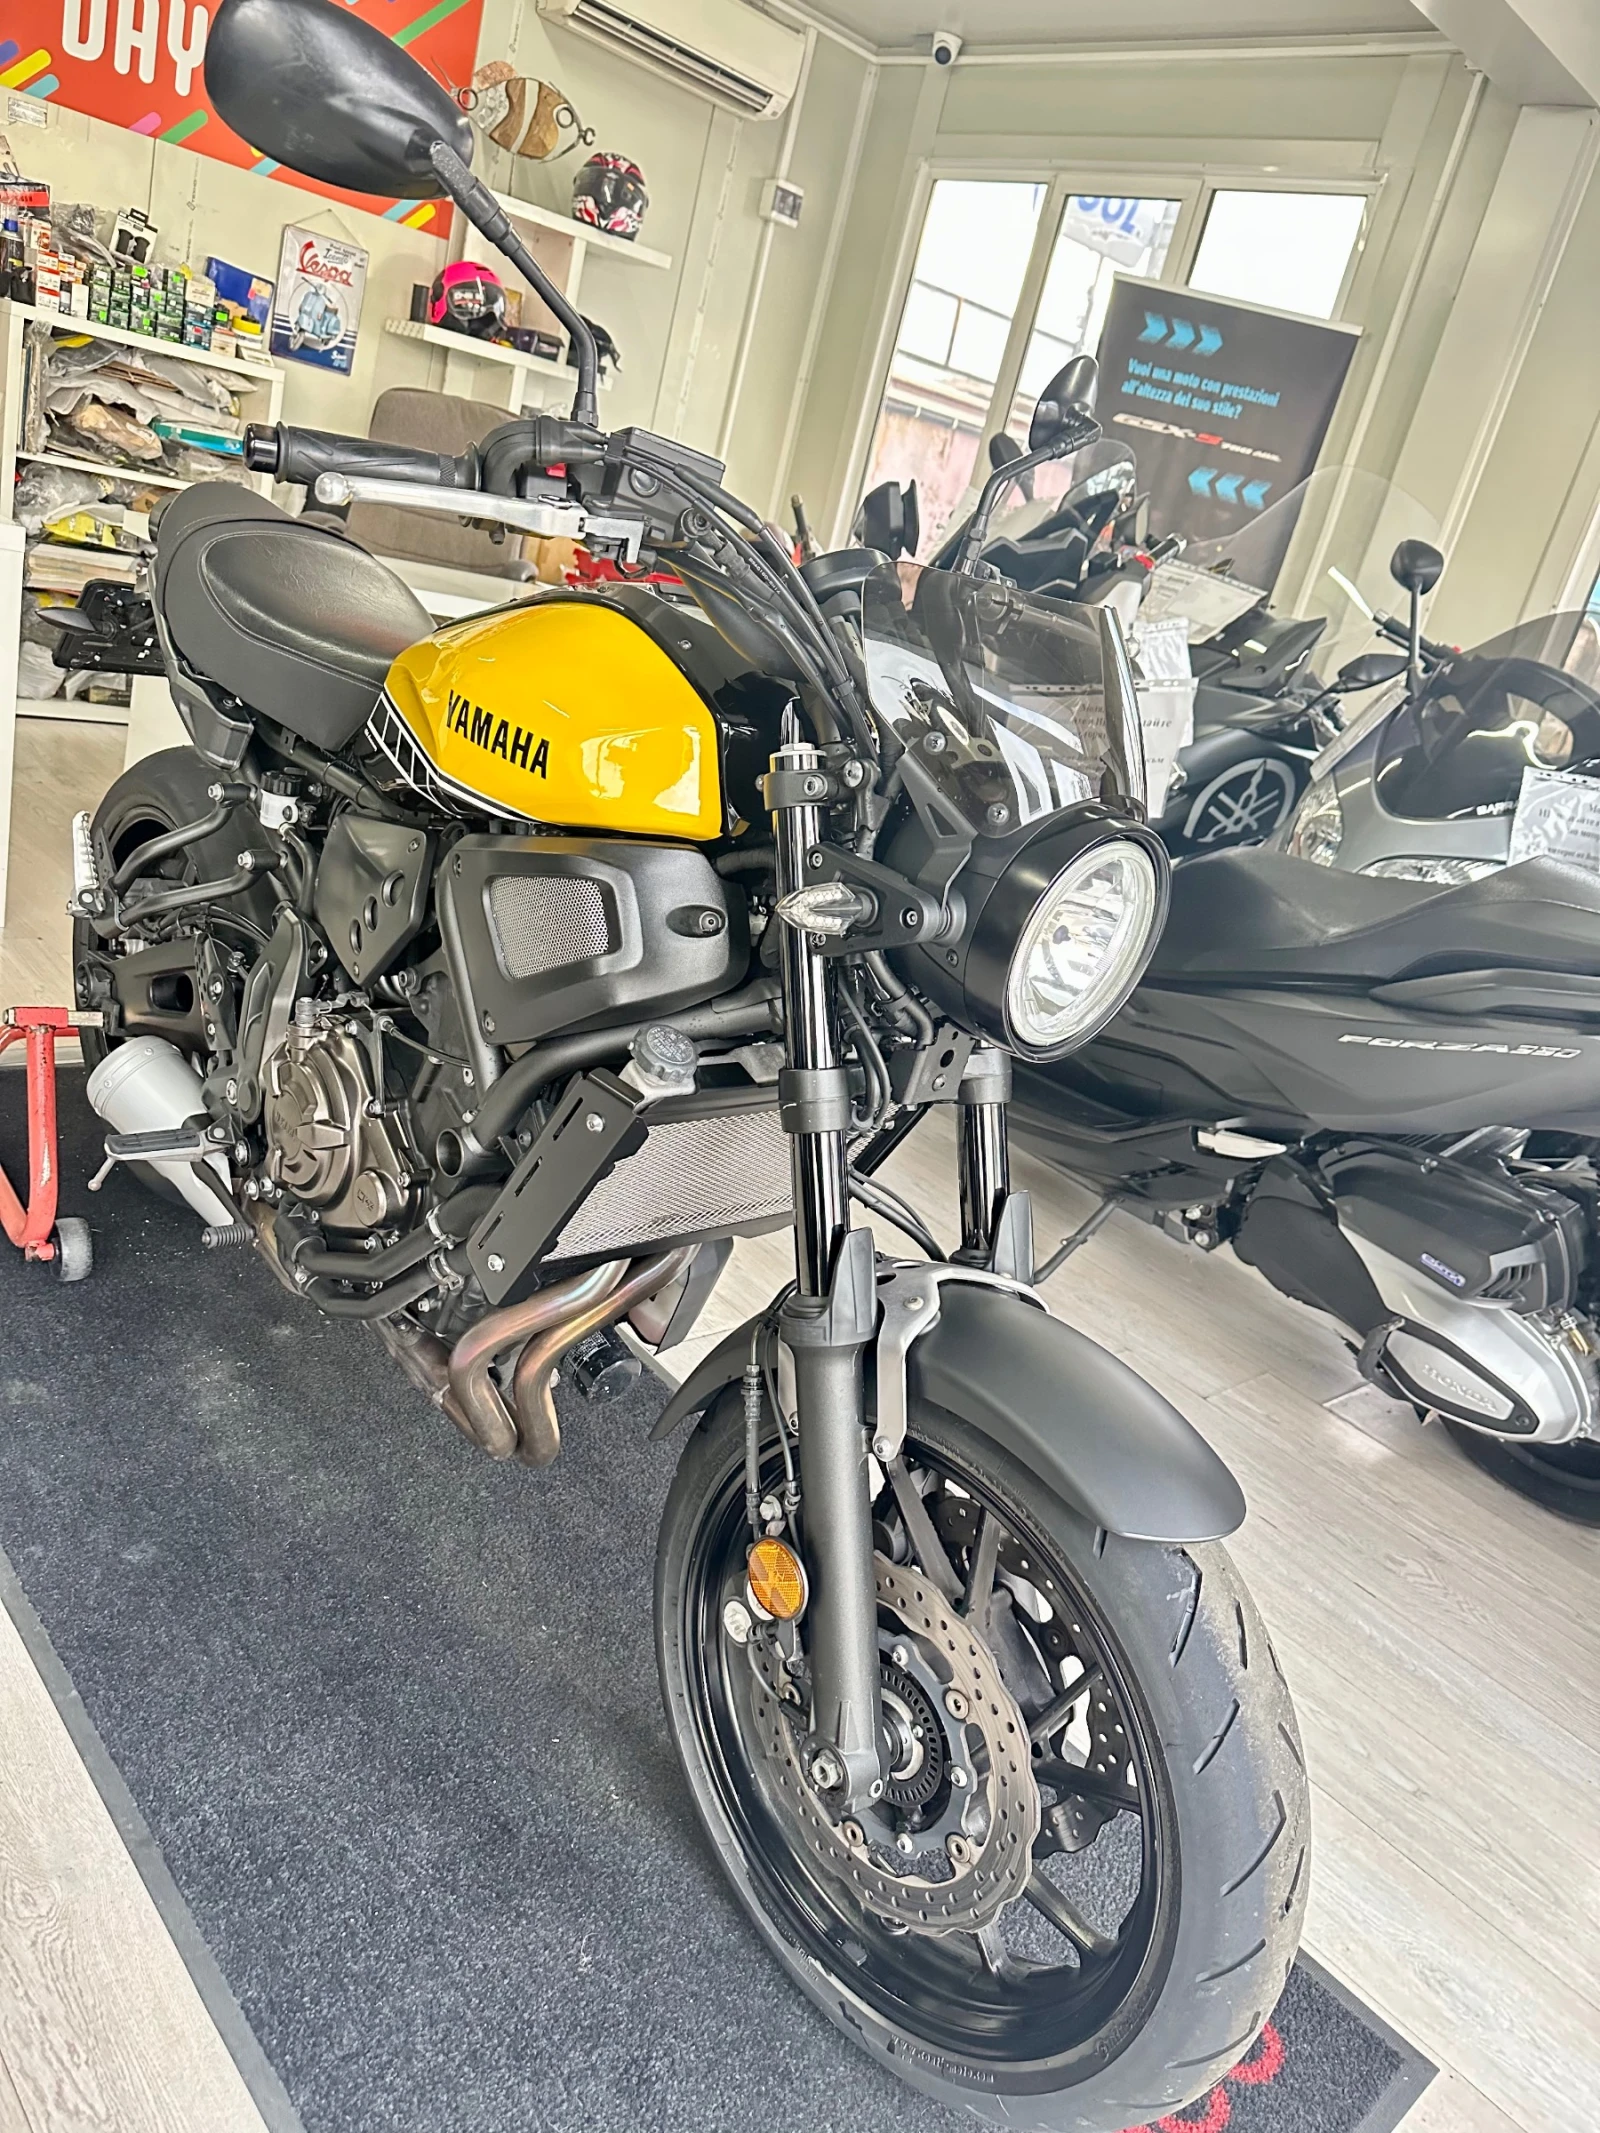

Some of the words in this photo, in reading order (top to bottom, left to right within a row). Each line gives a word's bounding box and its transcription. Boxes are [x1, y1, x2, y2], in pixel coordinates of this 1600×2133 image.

[296, 240, 354, 287] Vespa
[1121, 379, 1173, 403] all'altezza
[1173, 390, 1192, 407] del
[1191, 397, 1211, 412] suo
[1211, 401, 1243, 419] stile?
[1128, 358, 1152, 377] Vuoi
[1152, 366, 1172, 383] una
[1173, 371, 1201, 389] moto
[1201, 378, 1222, 393] con
[1221, 382, 1280, 407] prestazioni
[446, 689, 550, 780] YAMAHA
[1422, 1364, 1498, 1413] HONDA
